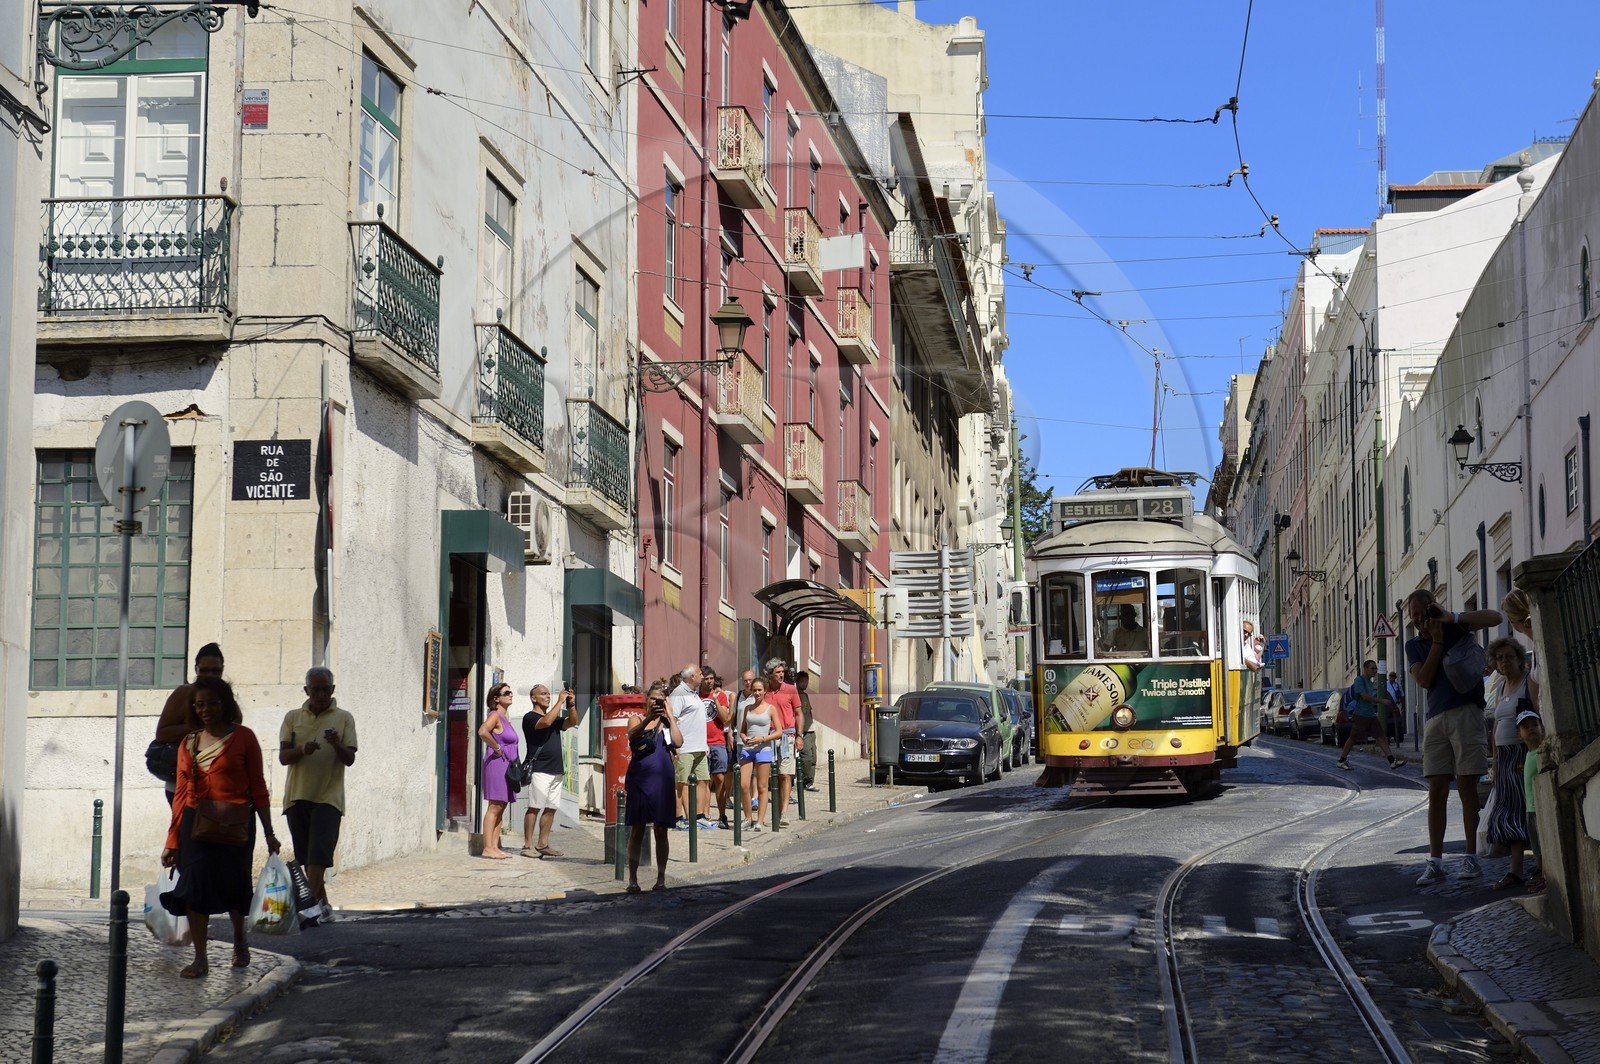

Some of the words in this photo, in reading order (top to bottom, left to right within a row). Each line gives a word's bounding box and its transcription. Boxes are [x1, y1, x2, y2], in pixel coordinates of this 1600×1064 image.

[260, 445, 284, 456] RUA
[266, 458, 280, 467] DE
[259, 468, 283, 482] SÃO
[245, 483, 296, 499] VICENTE
[1064, 503, 1134, 516] ESTRELA
[1150, 499, 1174, 516] 28
[1082, 667, 1120, 708] JAMESON
[1151, 679, 1178, 690] Triple
[1179, 678, 1211, 688] Distilled
[1141, 688, 1166, 697] Twice
